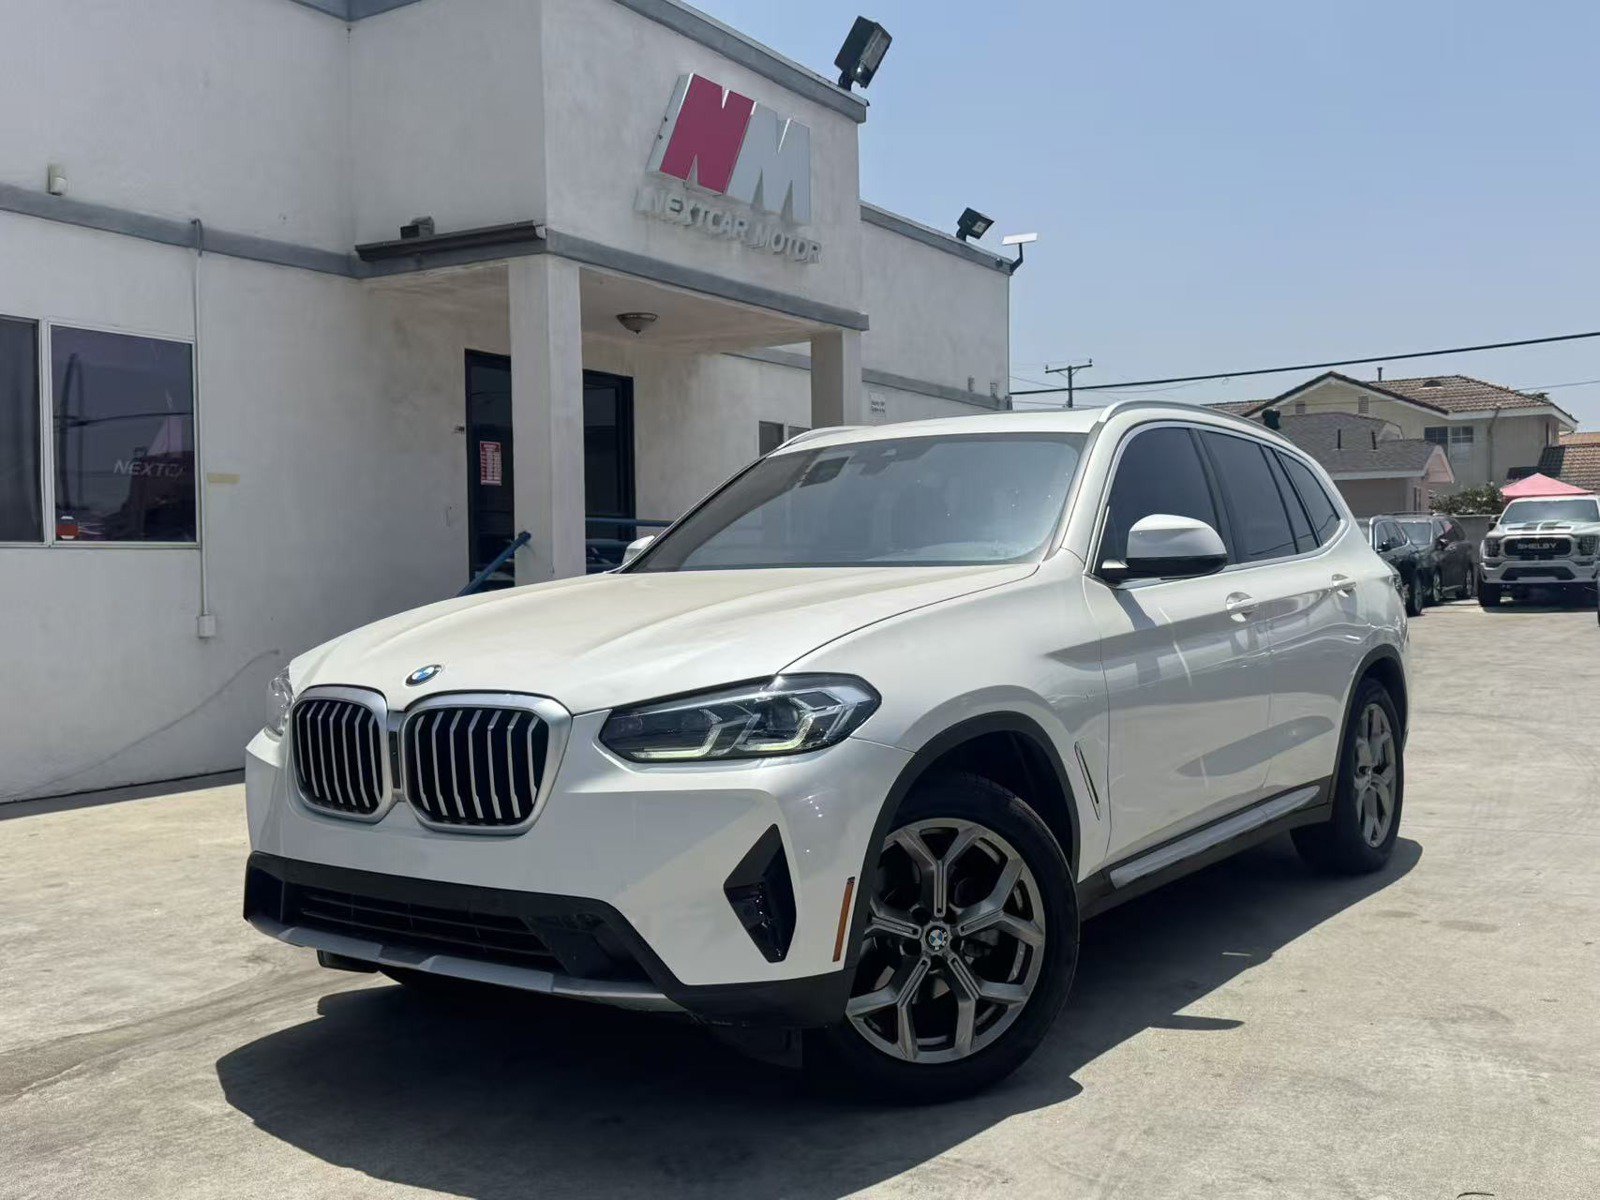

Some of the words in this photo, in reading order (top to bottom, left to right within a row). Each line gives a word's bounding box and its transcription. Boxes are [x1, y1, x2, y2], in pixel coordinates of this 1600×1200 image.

[639, 187, 751, 240] NEXTCAR
[749, 221, 823, 264] MOTOR
[1517, 542, 1557, 550] SHELBY
